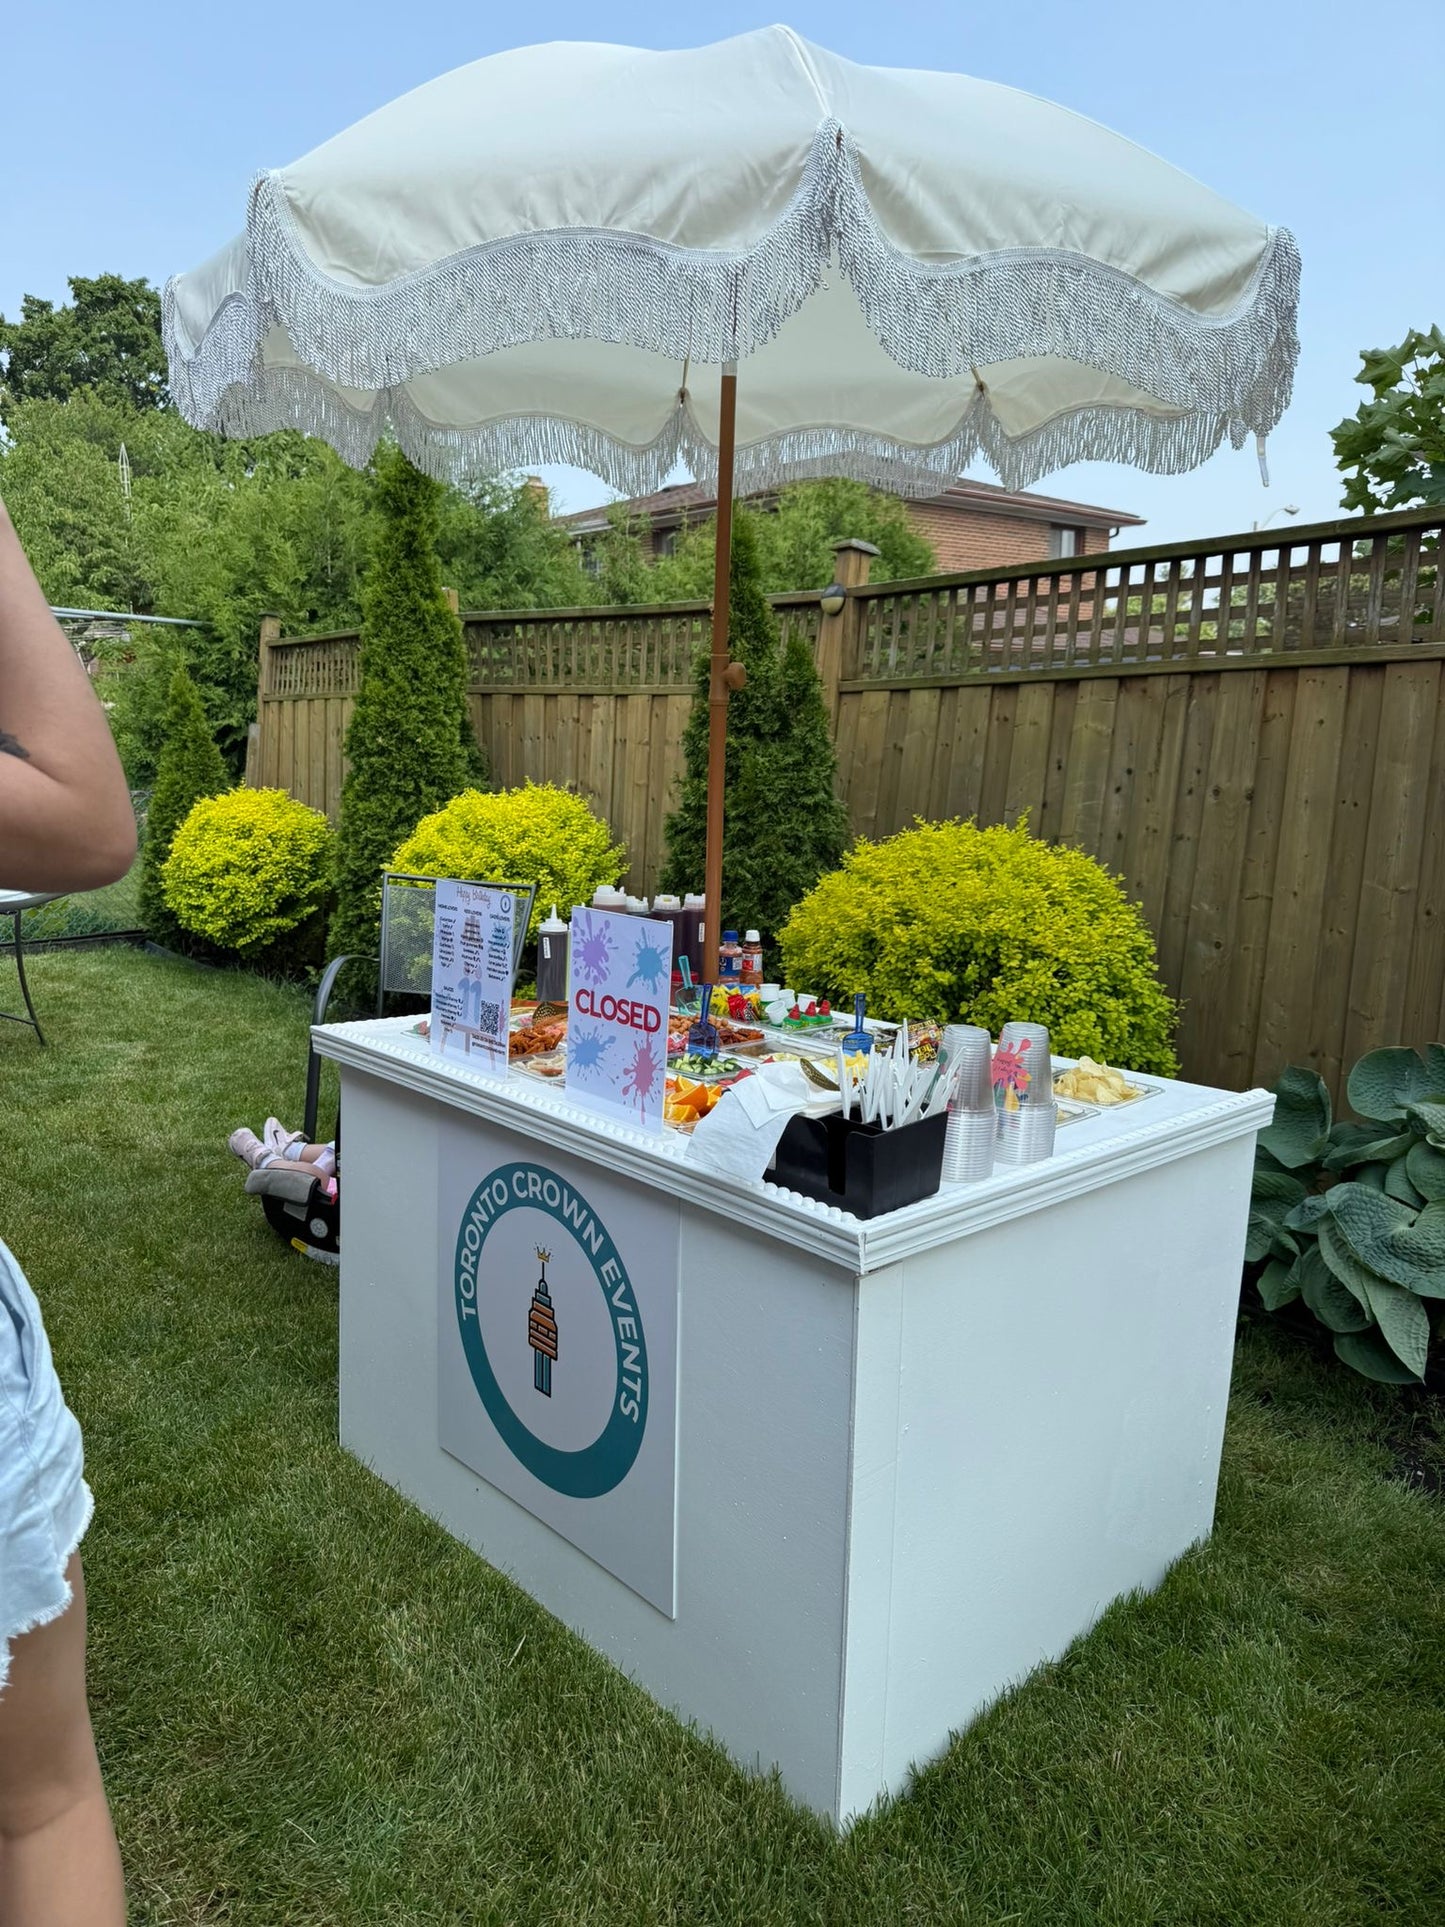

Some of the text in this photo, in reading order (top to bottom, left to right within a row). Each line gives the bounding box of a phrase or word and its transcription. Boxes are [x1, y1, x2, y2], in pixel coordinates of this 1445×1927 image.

[575, 988, 661, 1033] CLOSED
[460, 1170, 643, 1424] TORONTO CROWN EVENTS
